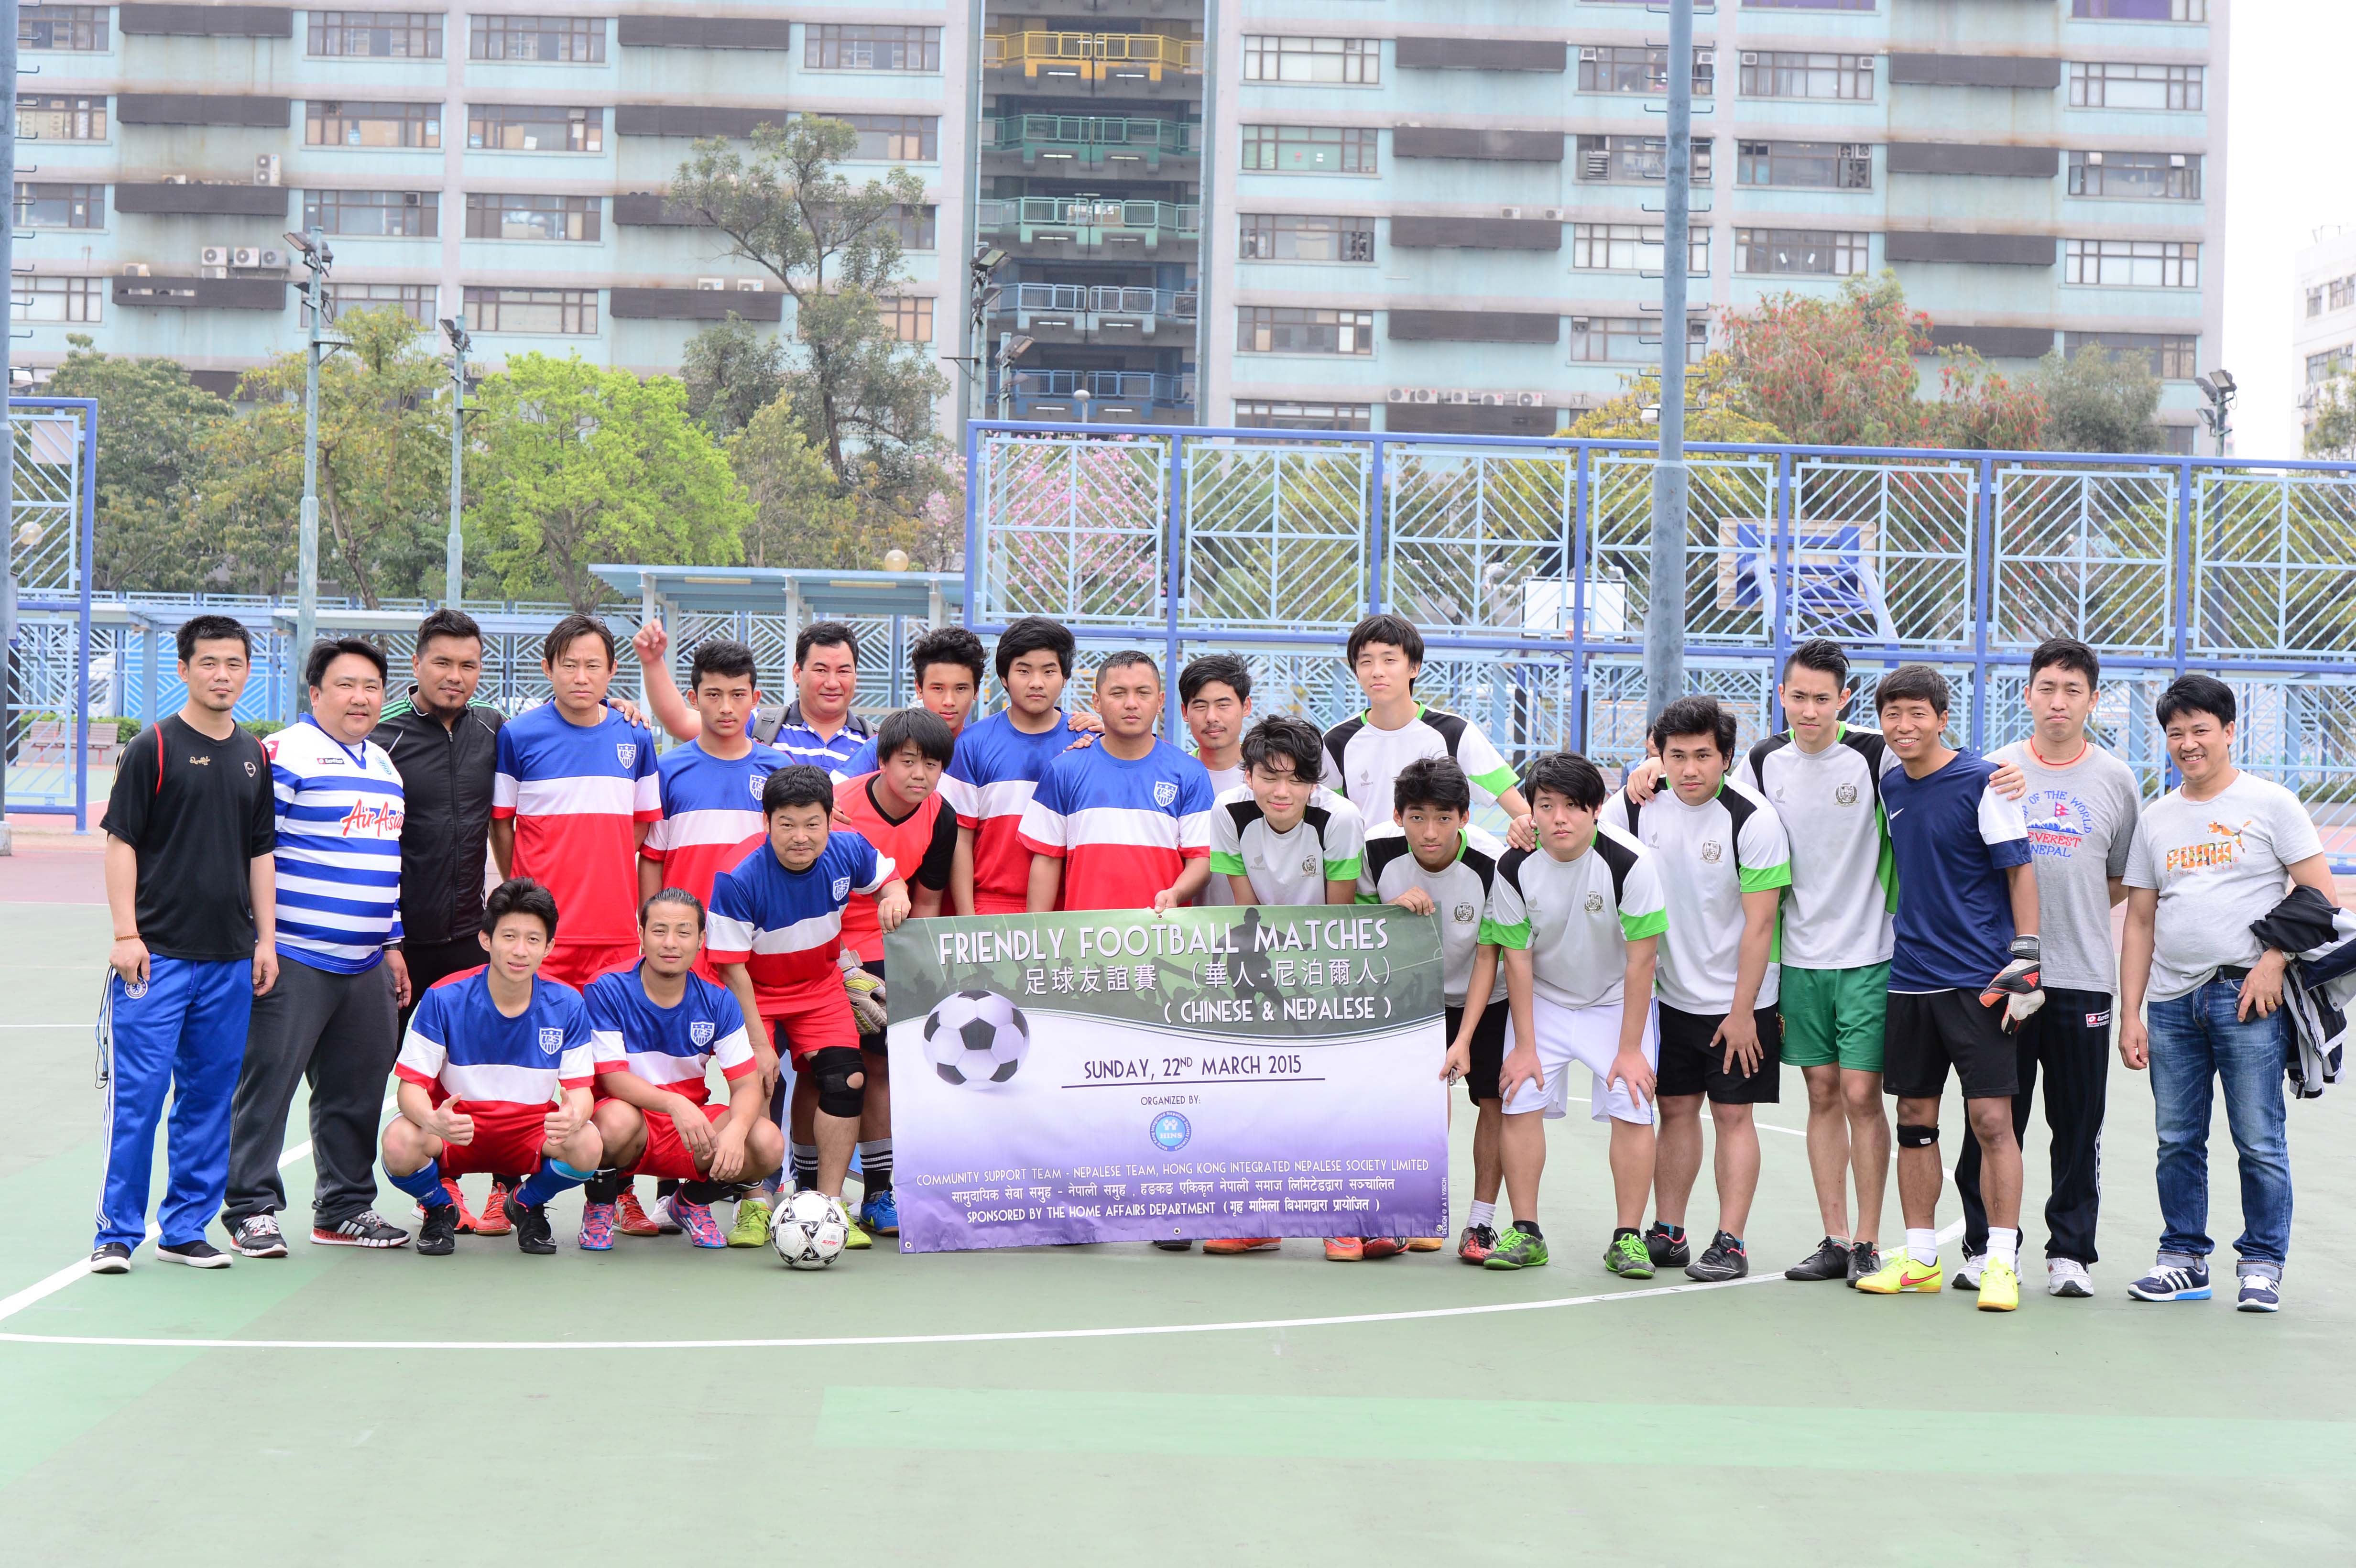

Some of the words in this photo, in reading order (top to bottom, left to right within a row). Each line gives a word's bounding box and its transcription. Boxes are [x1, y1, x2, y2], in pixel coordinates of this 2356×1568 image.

[2029, 793, 2040, 805] OF
[2044, 790, 2068, 800] THE
[2070, 797, 2093, 834] WORLD
[2028, 832, 2082, 848] EVEREST
[2030, 844, 2072, 858] NEPAL
[2167, 841, 2232, 871] PUMA
[938, 928, 1065, 965] FRIENDLY
[1080, 922, 1239, 958] FOOTBALL
[1254, 918, 1388, 953] MATCHES
[1025, 964, 1157, 995] 足球友誼賽
[1262, 1001, 1275, 1022] &
[1283, 997, 1375, 1021] NEPALESE
[1084, 1058, 1155, 1081] SUNDAY,
[1162, 1057, 1193, 1077] 22ND
[1201, 1056, 1261, 1075] MARCH
[1268, 1055, 1302, 1074] 2015
[1140, 1096, 1186, 1106] ORGANIZED
[1189, 1095, 1201, 1105] BY:
[916, 1171, 979, 1186] COMMUNITY
[984, 1168, 1026, 1182] SUPPORT
[1032, 1168, 1062, 1179] TEAM
[1073, 1165, 1122, 1178] NEPALESE
[1125, 1164, 1158, 1177] TEAM,
[1163, 1163, 1192, 1175] HONG
[1197, 1162, 1226, 1174] KONG
[1230, 1161, 1290, 1173] INTEGRATED
[1295, 1160, 1342, 1172] NEPALESE
[1346, 1159, 1387, 1171] SOCIETY
[1391, 1159, 1429, 1171] LIMITED
[951, 1187, 1000, 1208] सामुदायिक
[1004, 1185, 1023, 1200] सेवा
[1029, 1185, 1052, 1203] समुह
[1068, 1182, 1098, 1197] नेपाली
[1103, 1183, 1127, 1200] समुह
[1179, 1179, 1214, 1197] एकिकृत
[1220, 1177, 1249, 1192] नेपाली
[1255, 1180, 1283, 1192] समाज
[967, 1209, 1025, 1224] SPONSORED
[1029, 1208, 1042, 1220] BY
[1046, 1206, 1065, 1219] THE
[1069, 1205, 1101, 1218] HOME
[1105, 1204, 1145, 1217] AFFAIRS
[1150, 1202, 1215, 1215] DEPARTMENT
[1249, 1197, 1280, 1212] मामिला
[1333, 1195, 1370, 1212] प्रायोजित
